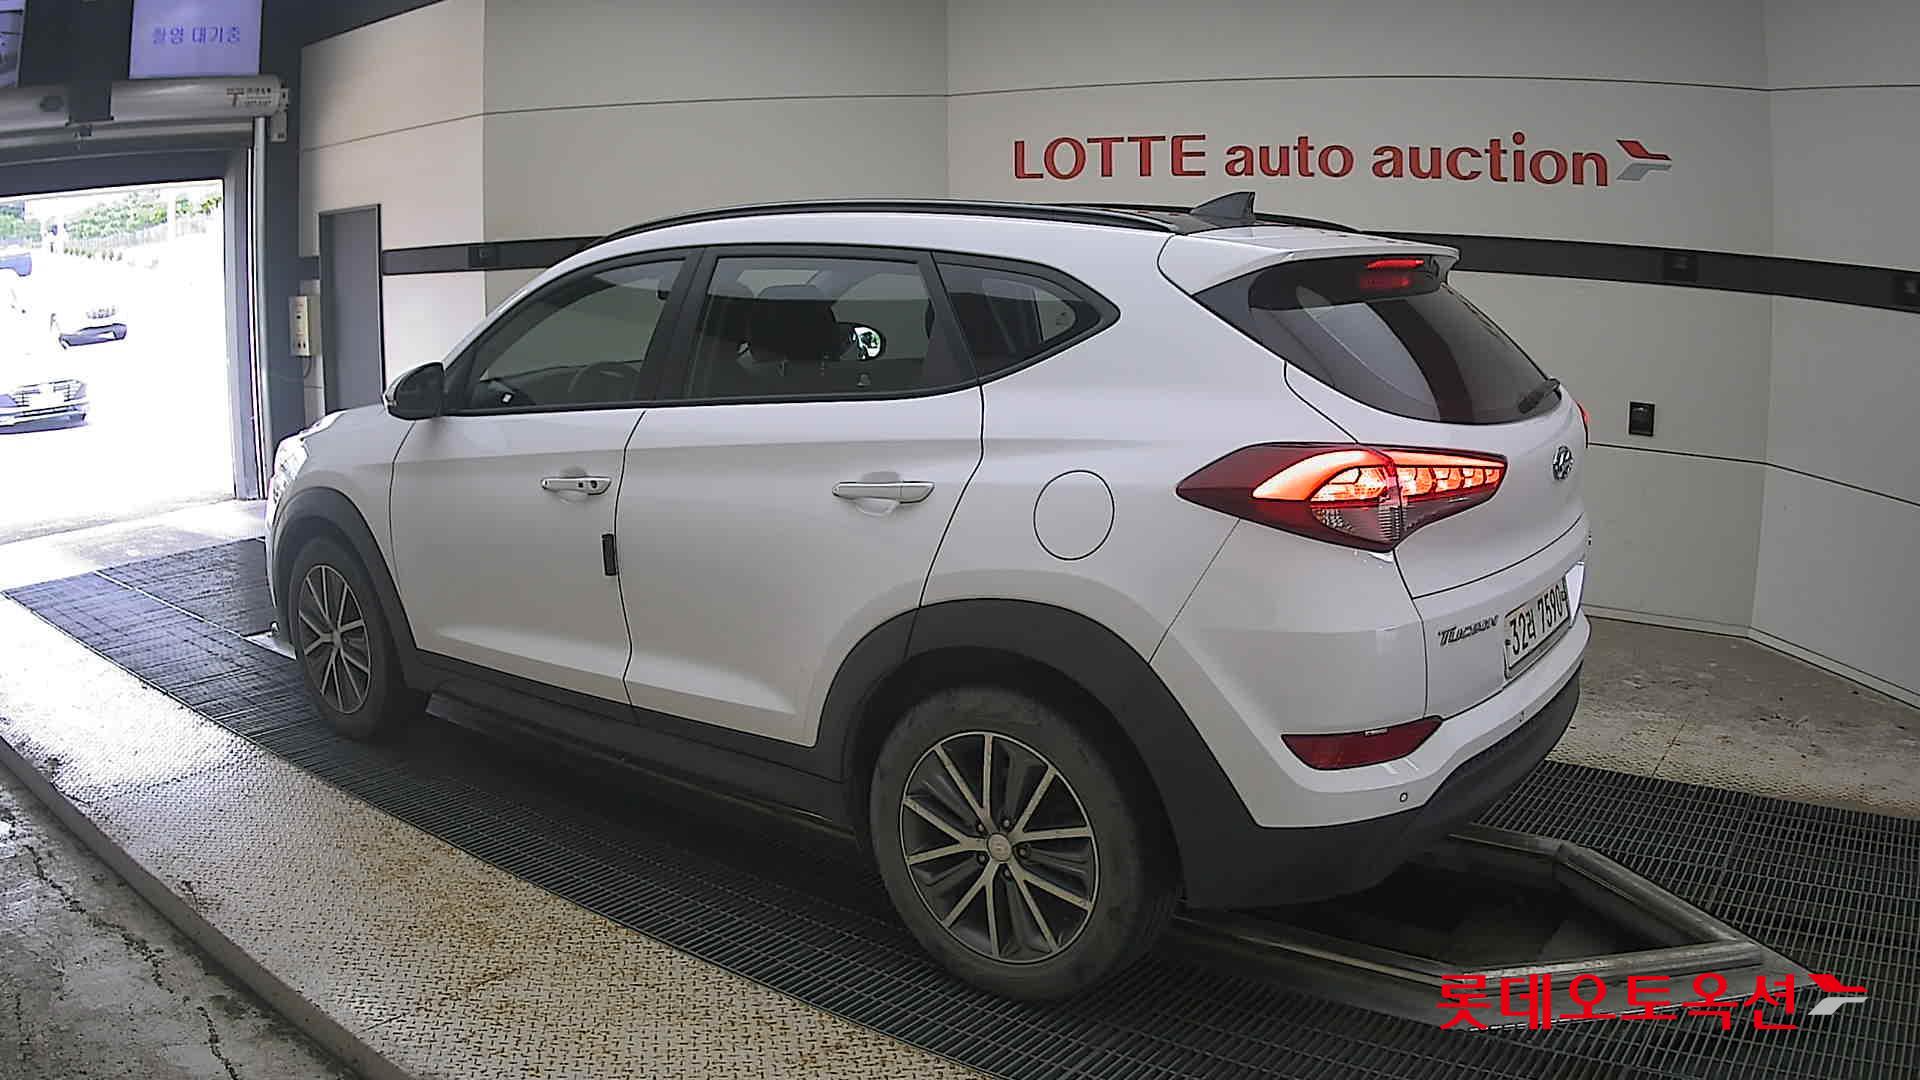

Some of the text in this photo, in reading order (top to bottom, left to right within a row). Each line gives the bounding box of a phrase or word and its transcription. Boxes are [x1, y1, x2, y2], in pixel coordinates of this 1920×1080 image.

[1014, 131, 1609, 187] LOTTE auto auction
[1538, 584, 1563, 633] 7590
